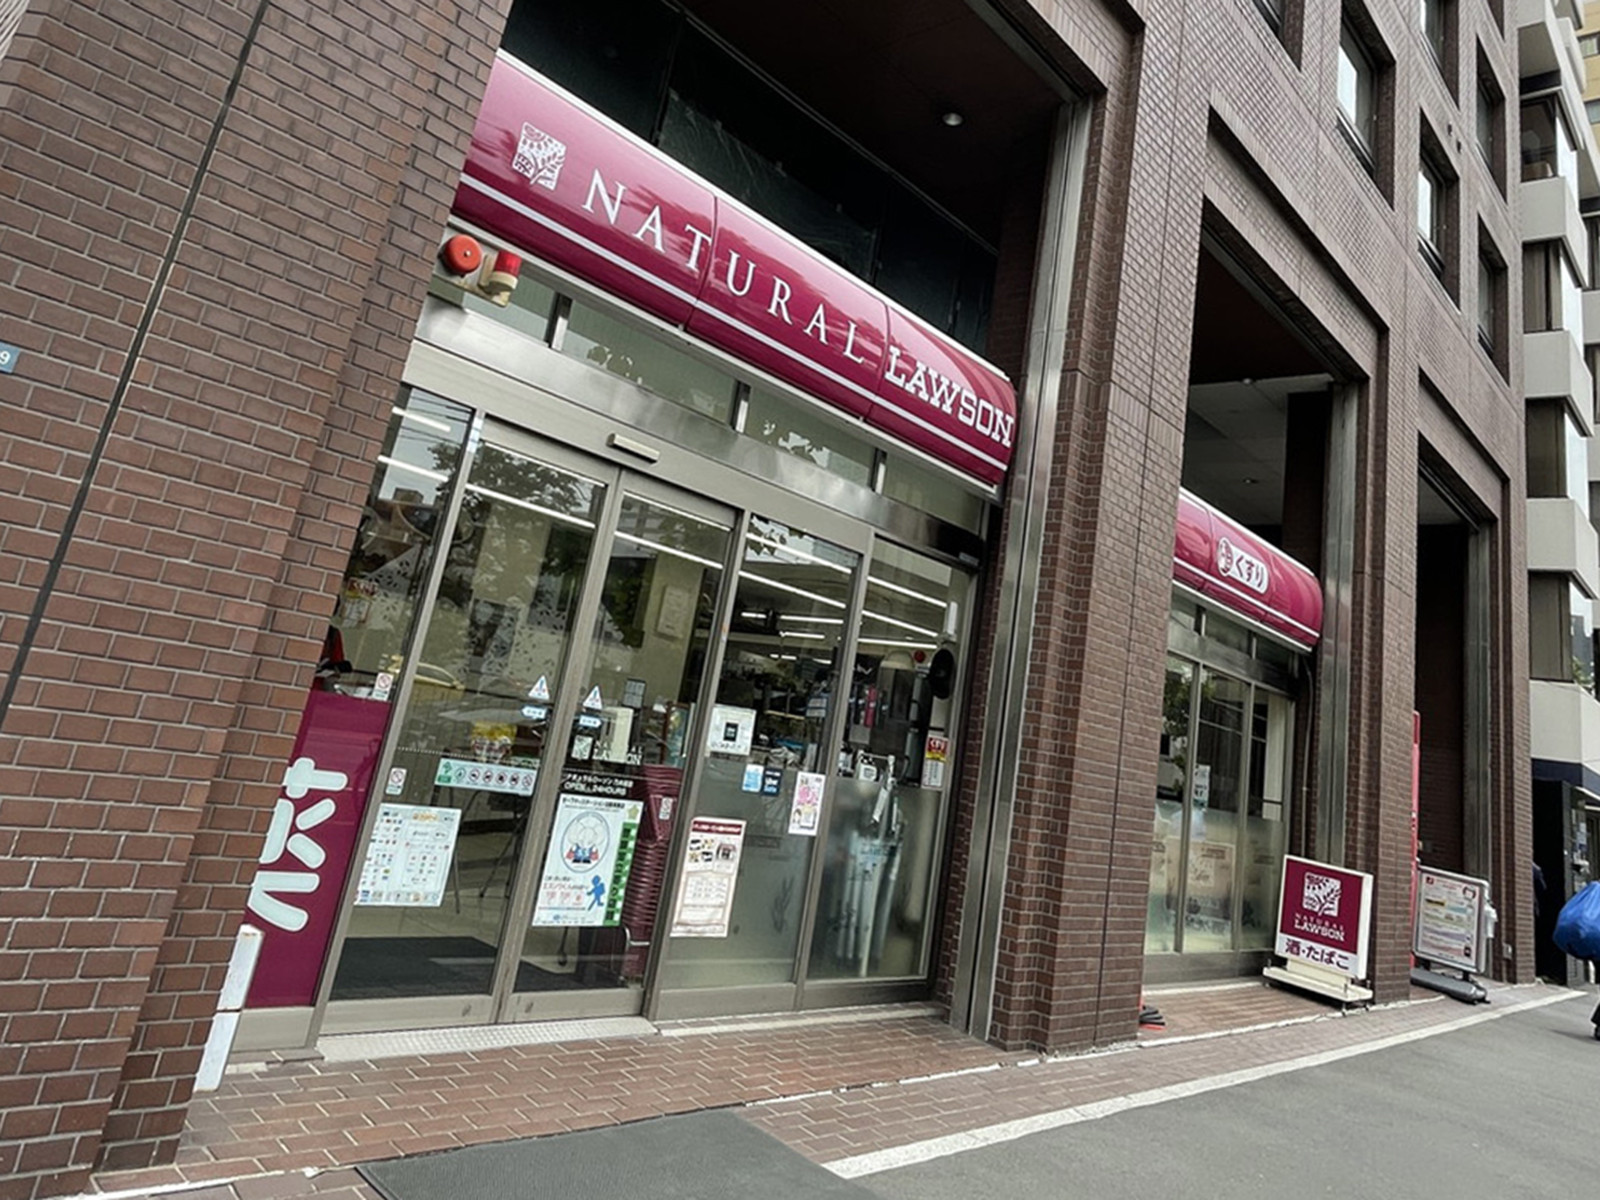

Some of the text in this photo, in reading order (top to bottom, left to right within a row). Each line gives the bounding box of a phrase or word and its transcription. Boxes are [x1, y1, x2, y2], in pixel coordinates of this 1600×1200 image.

[581, 168, 1015, 448] NATURAL LAWSON
[1235, 554, 1265, 588] くすり
[1294, 919, 1345, 942] LAWSON
[1295, 913, 1344, 931] NATURAL
[1285, 938, 1350, 970] 酒・たばこ
